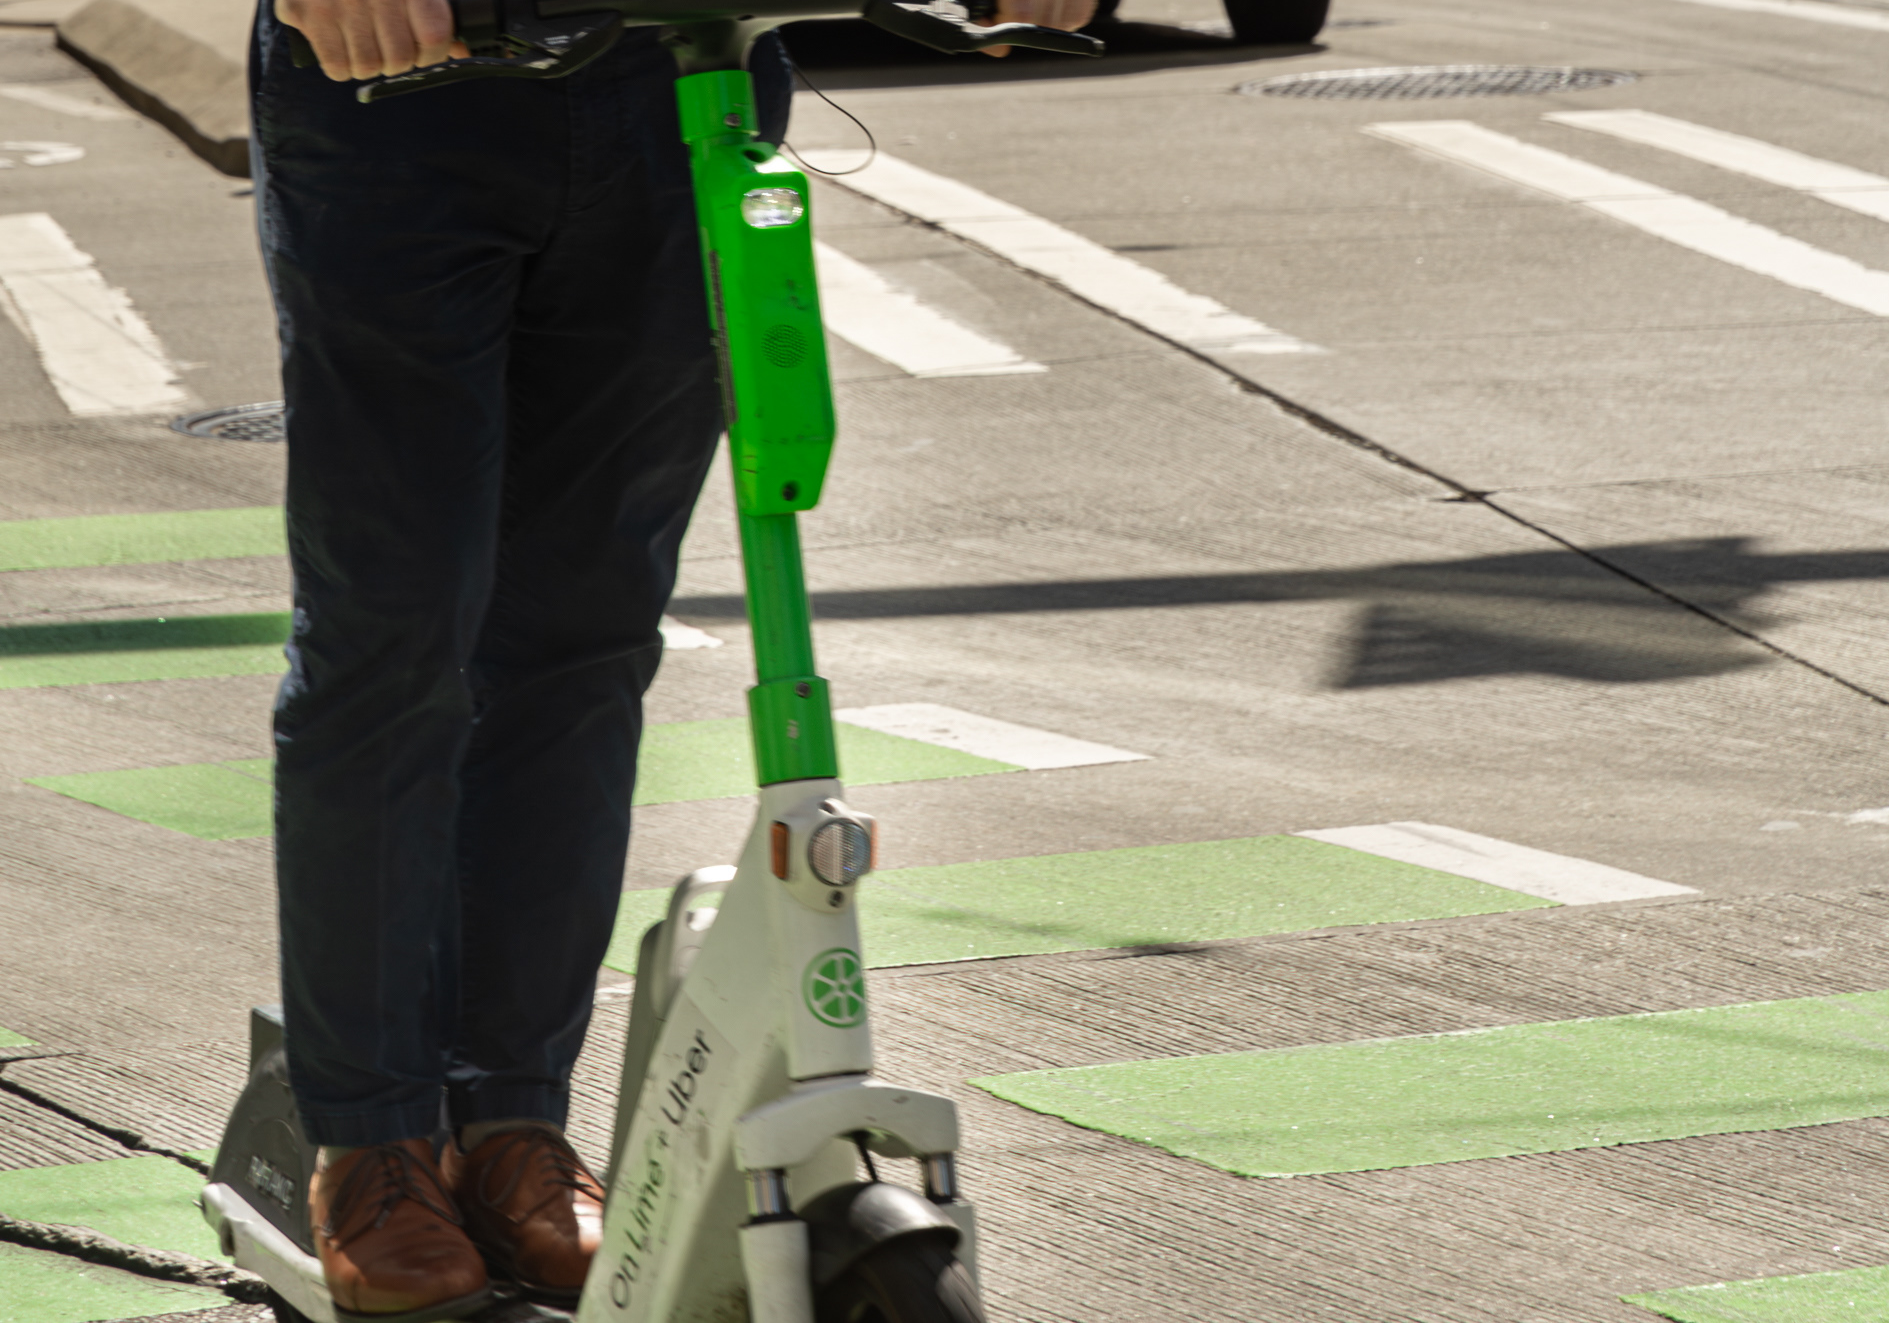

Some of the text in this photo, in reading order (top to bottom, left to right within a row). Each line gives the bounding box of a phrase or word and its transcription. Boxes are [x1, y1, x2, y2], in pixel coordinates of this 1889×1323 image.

[609, 1251, 640, 1311] On
[625, 1158, 664, 1252] Lime
[660, 1029, 712, 1126] Uber
